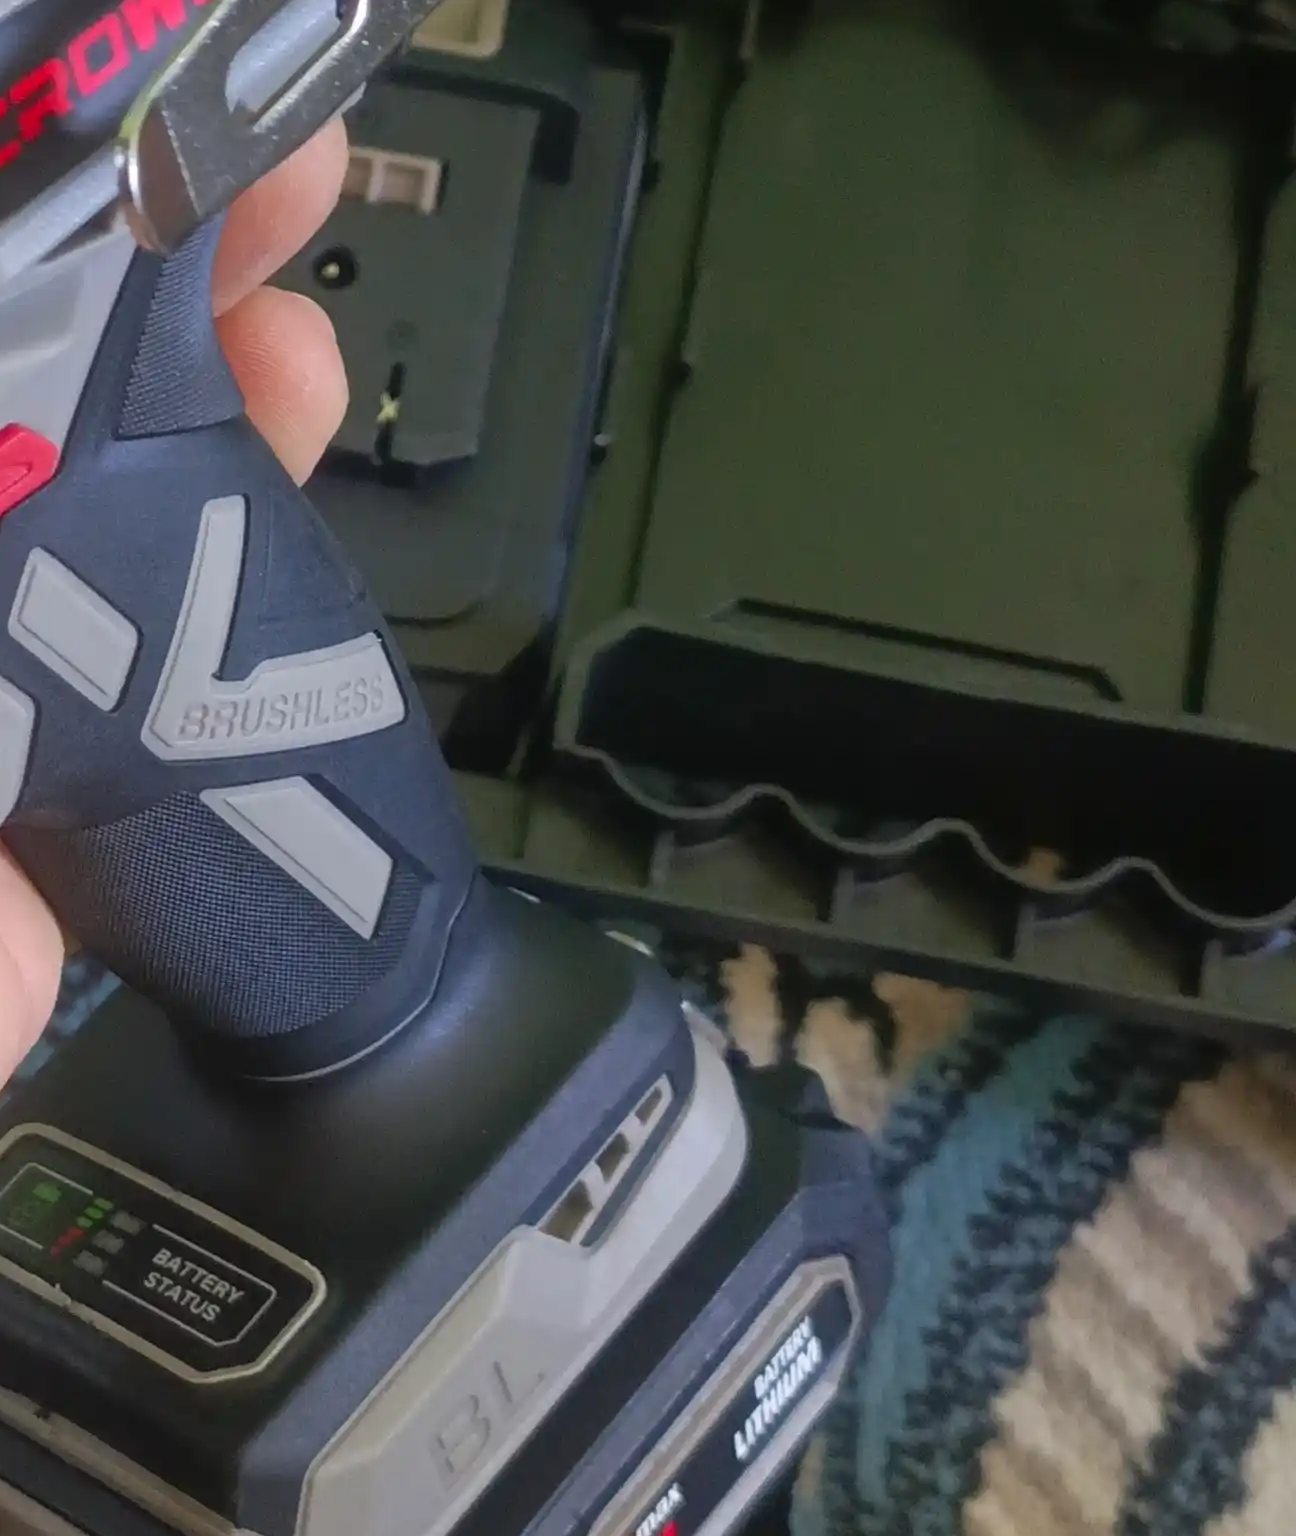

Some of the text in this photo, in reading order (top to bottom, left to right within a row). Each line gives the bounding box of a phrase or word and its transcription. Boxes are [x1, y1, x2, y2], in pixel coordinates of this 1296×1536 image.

[178, 675, 386, 742] BRUSHLESS
[143, 1271, 222, 1323] STATUS
[152, 1247, 245, 1306] BATTERY
[733, 1336, 825, 1461] LITHIUM
